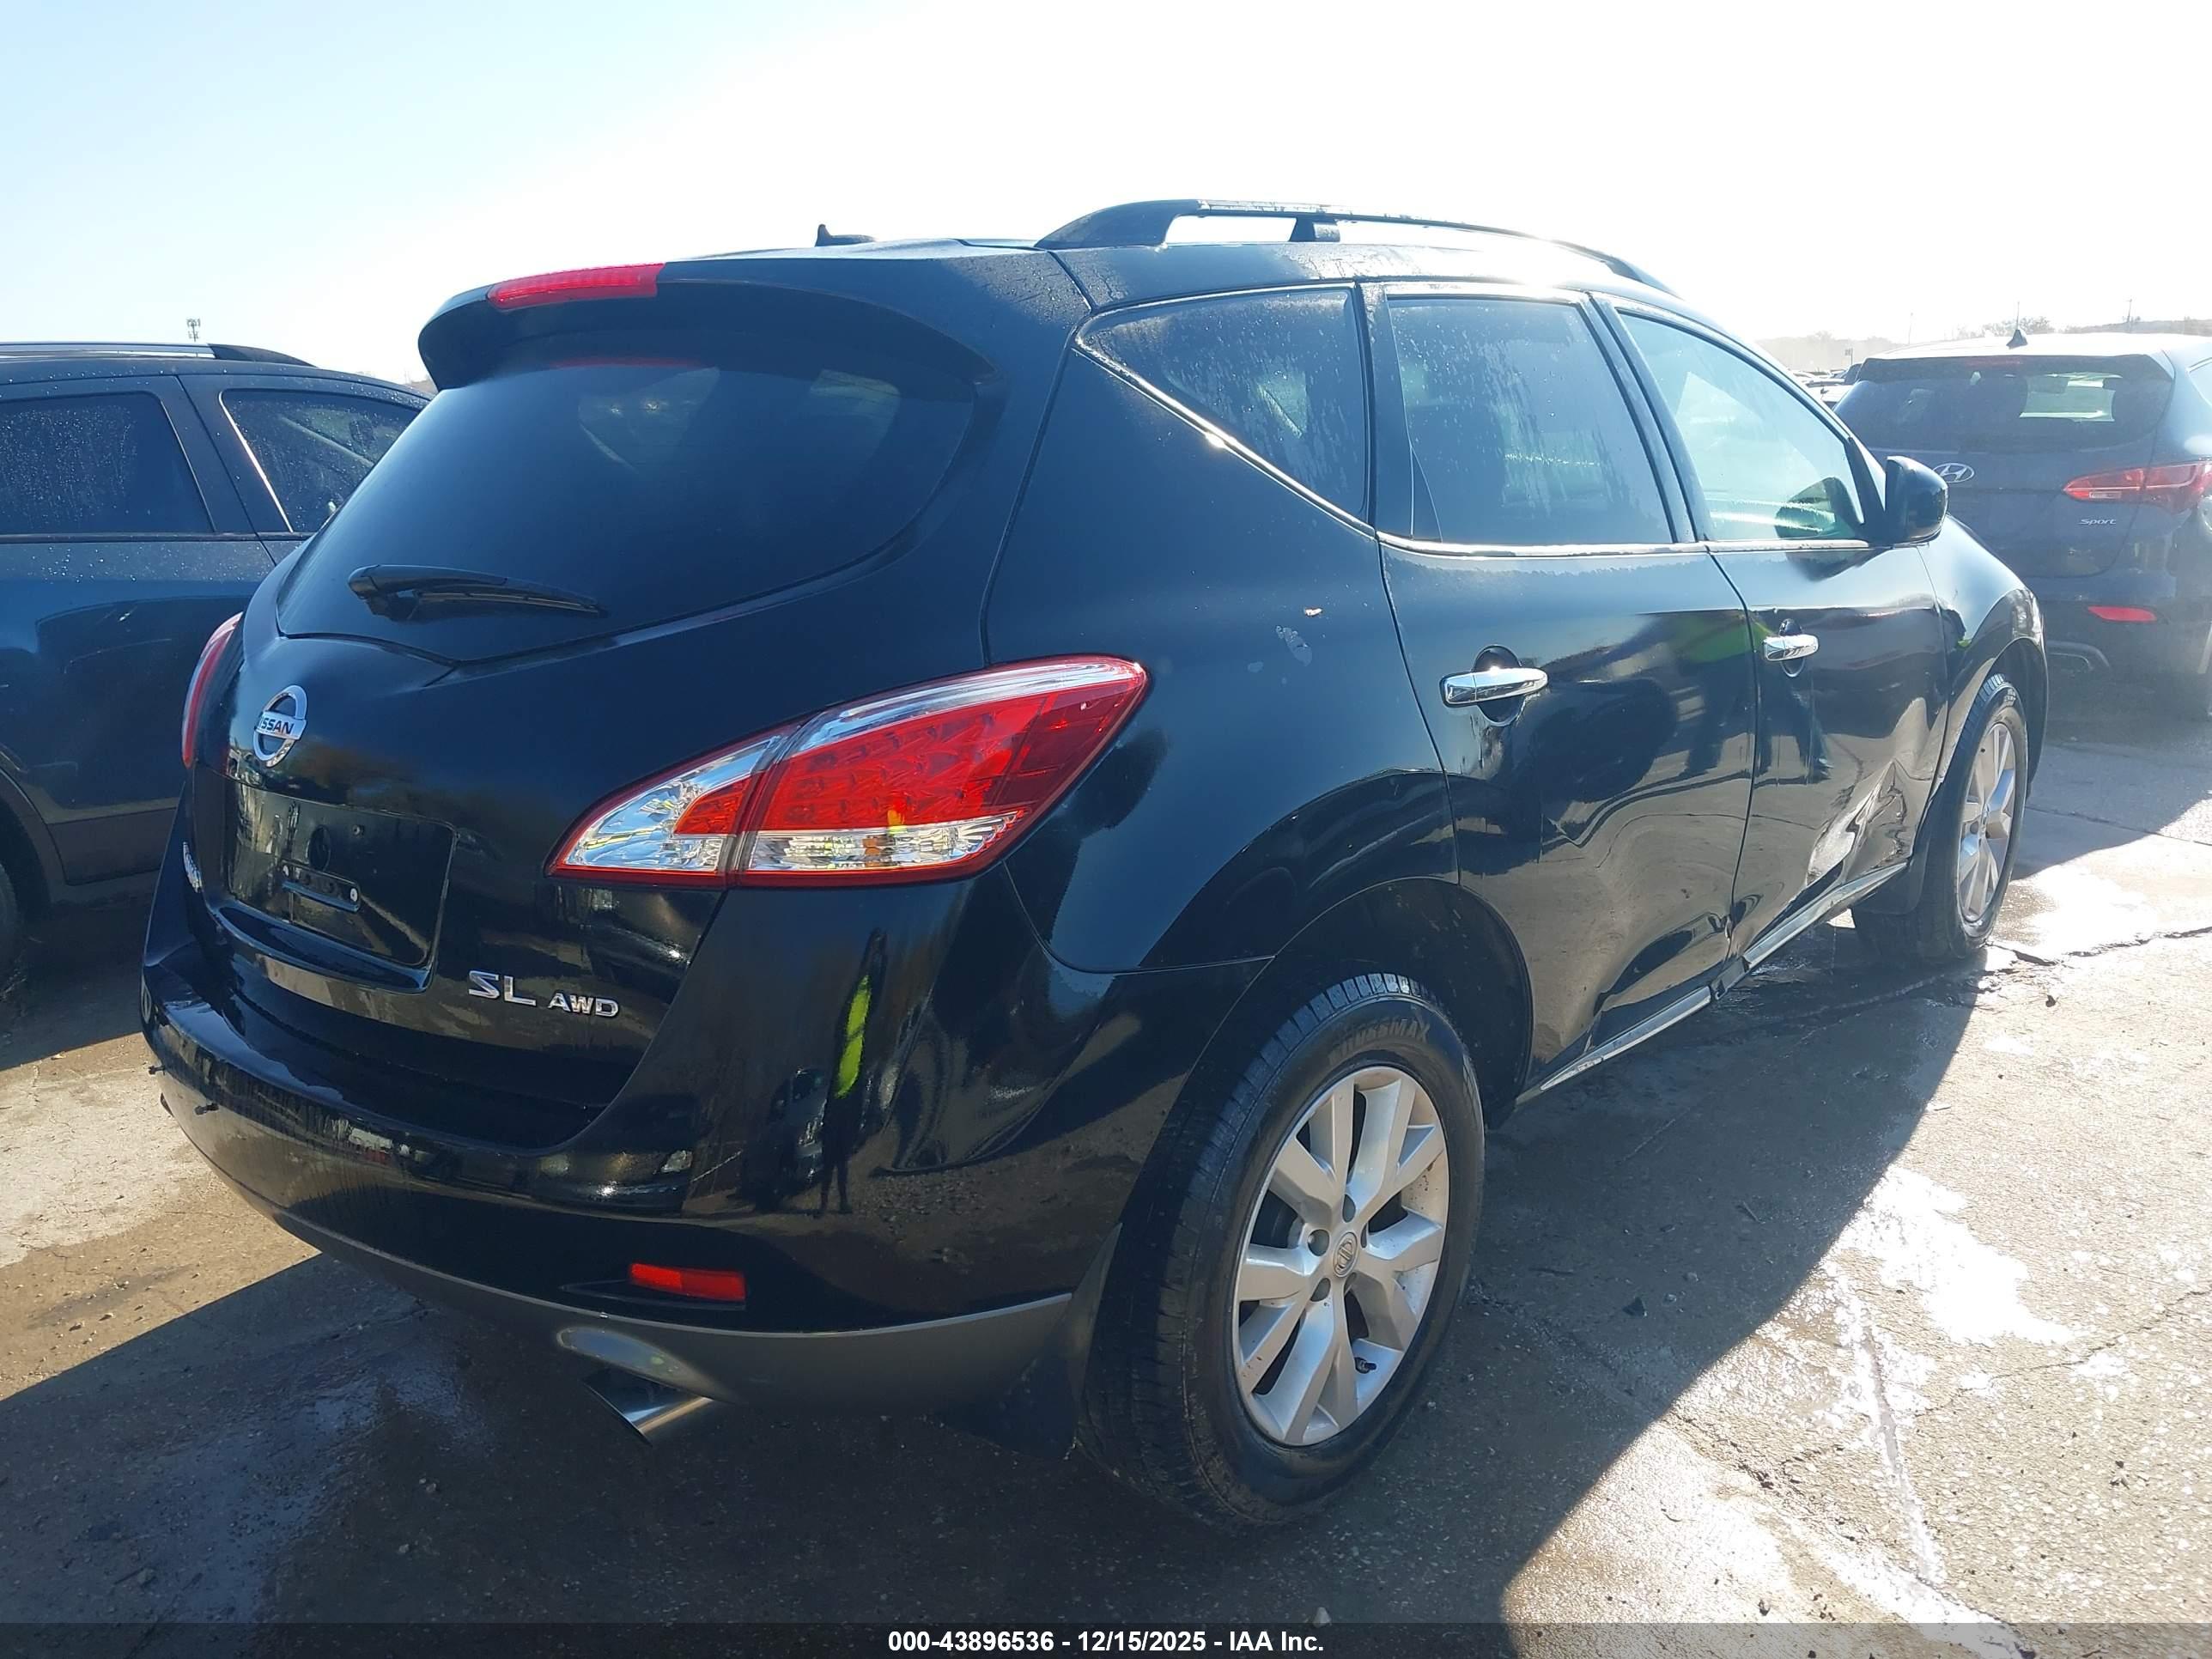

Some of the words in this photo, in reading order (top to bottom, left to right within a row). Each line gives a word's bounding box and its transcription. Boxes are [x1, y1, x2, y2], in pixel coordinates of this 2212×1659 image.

[258, 716, 295, 735] ISSAN
[468, 969, 537, 1007] SL
[547, 992, 620, 1018] AWD
